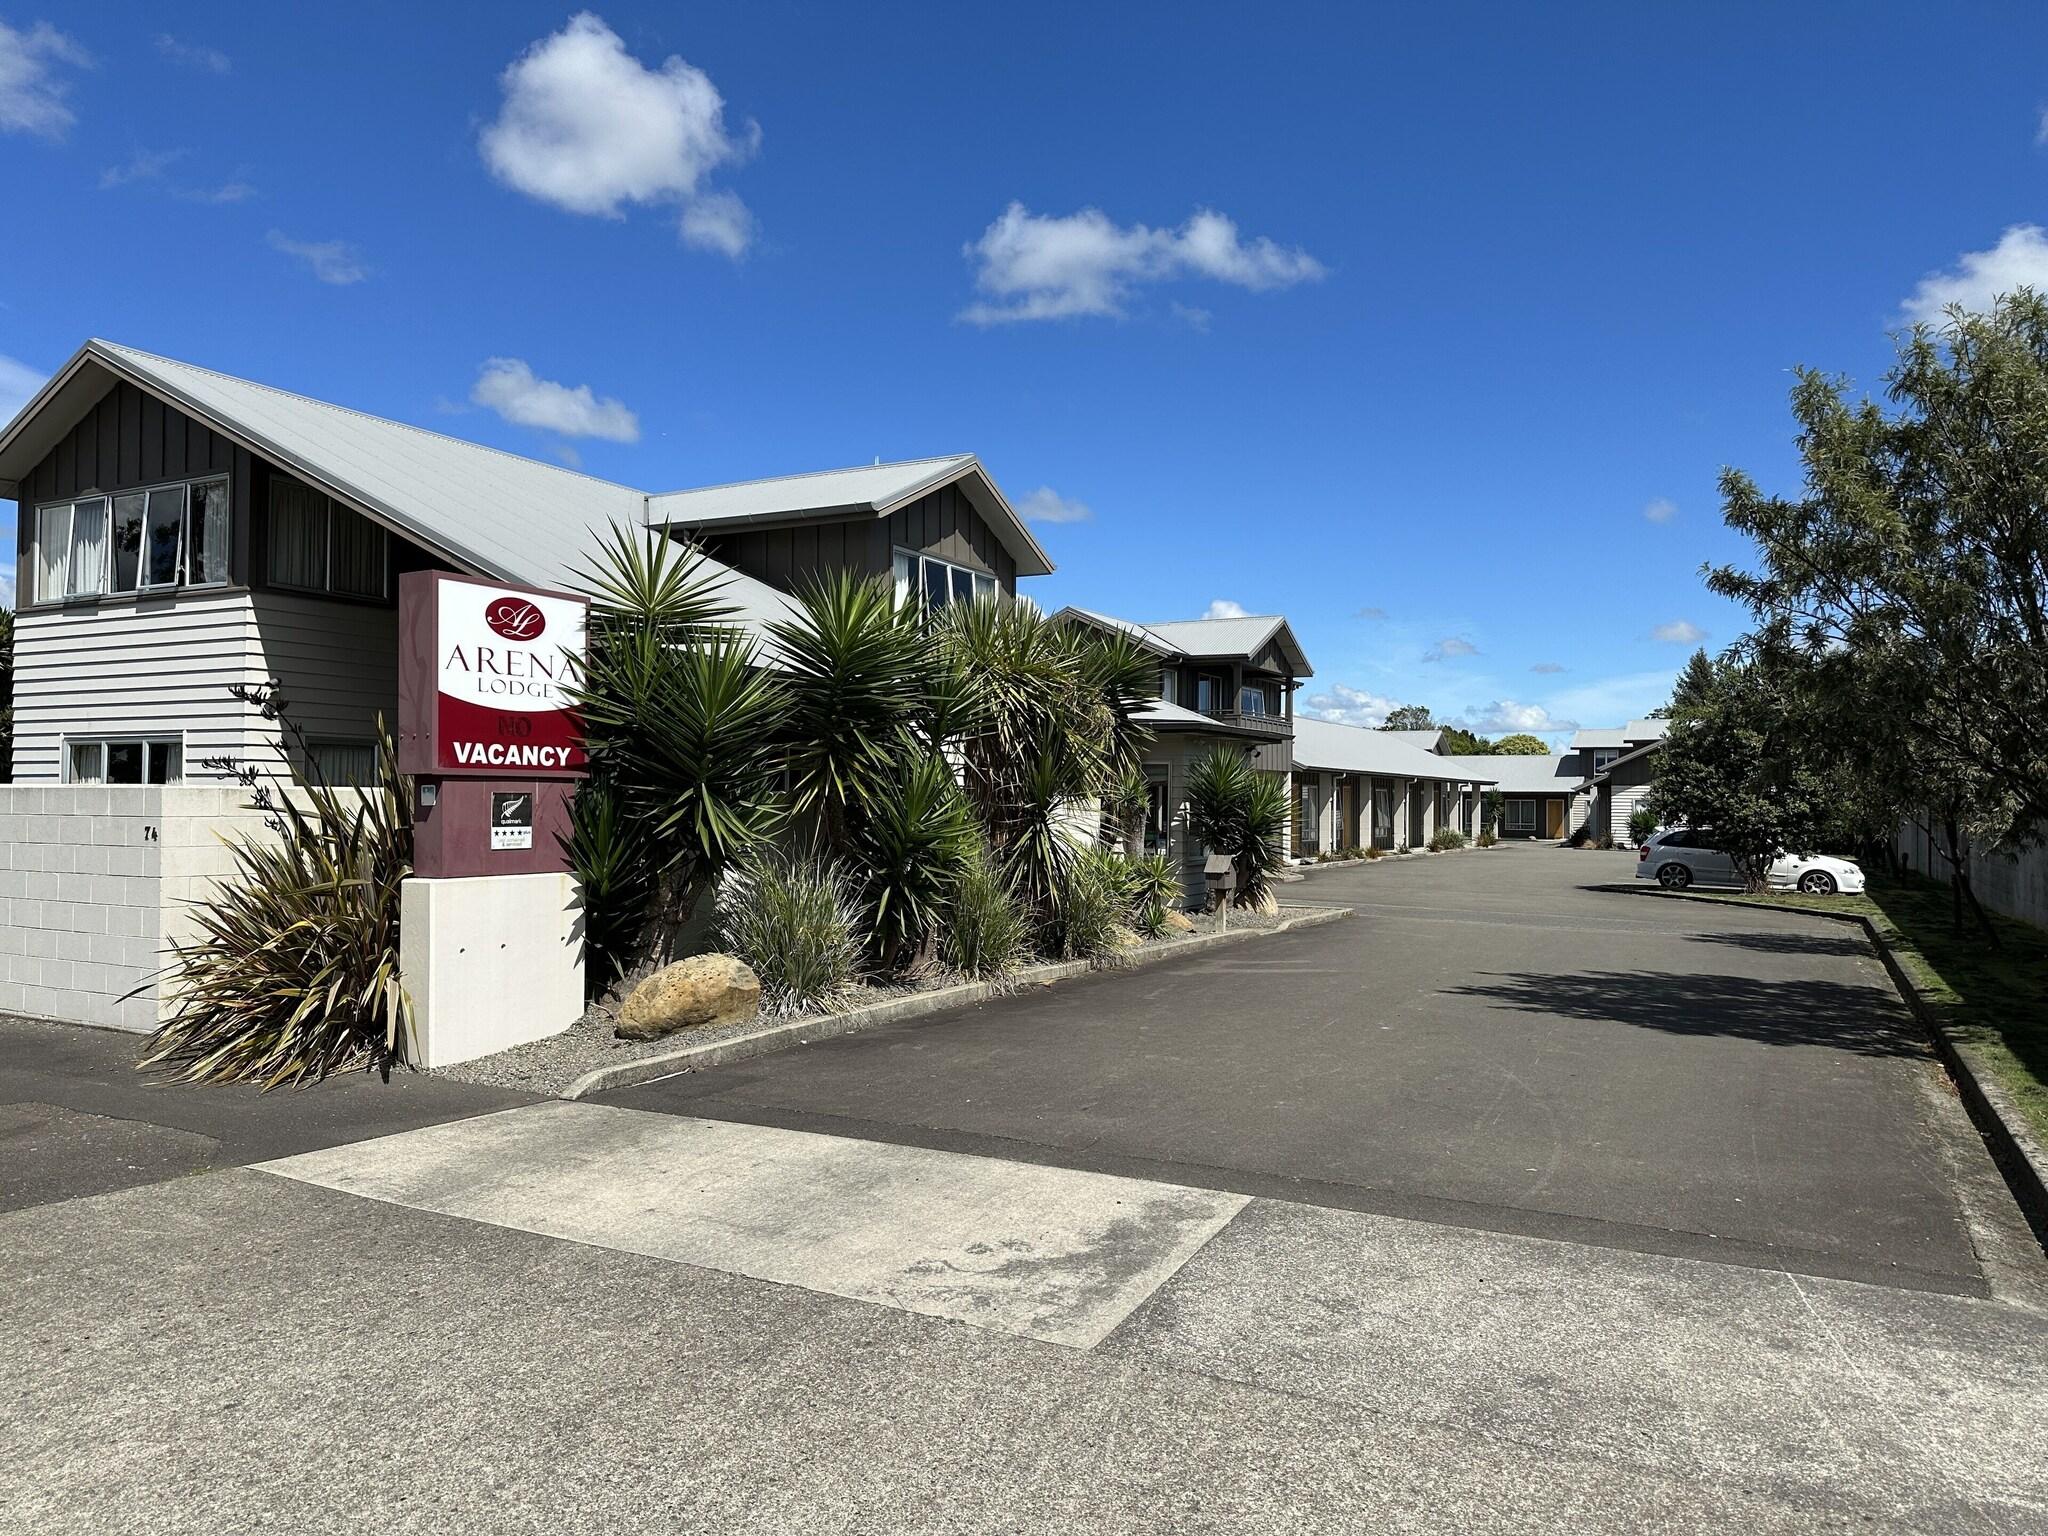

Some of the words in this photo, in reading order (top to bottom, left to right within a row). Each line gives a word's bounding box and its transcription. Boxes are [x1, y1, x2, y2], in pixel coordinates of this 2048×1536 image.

[445, 644, 579, 682] ARENA
[478, 677, 554, 698] LODGE
[452, 741, 571, 767] VACANCY
[144, 825, 158, 842] 74
